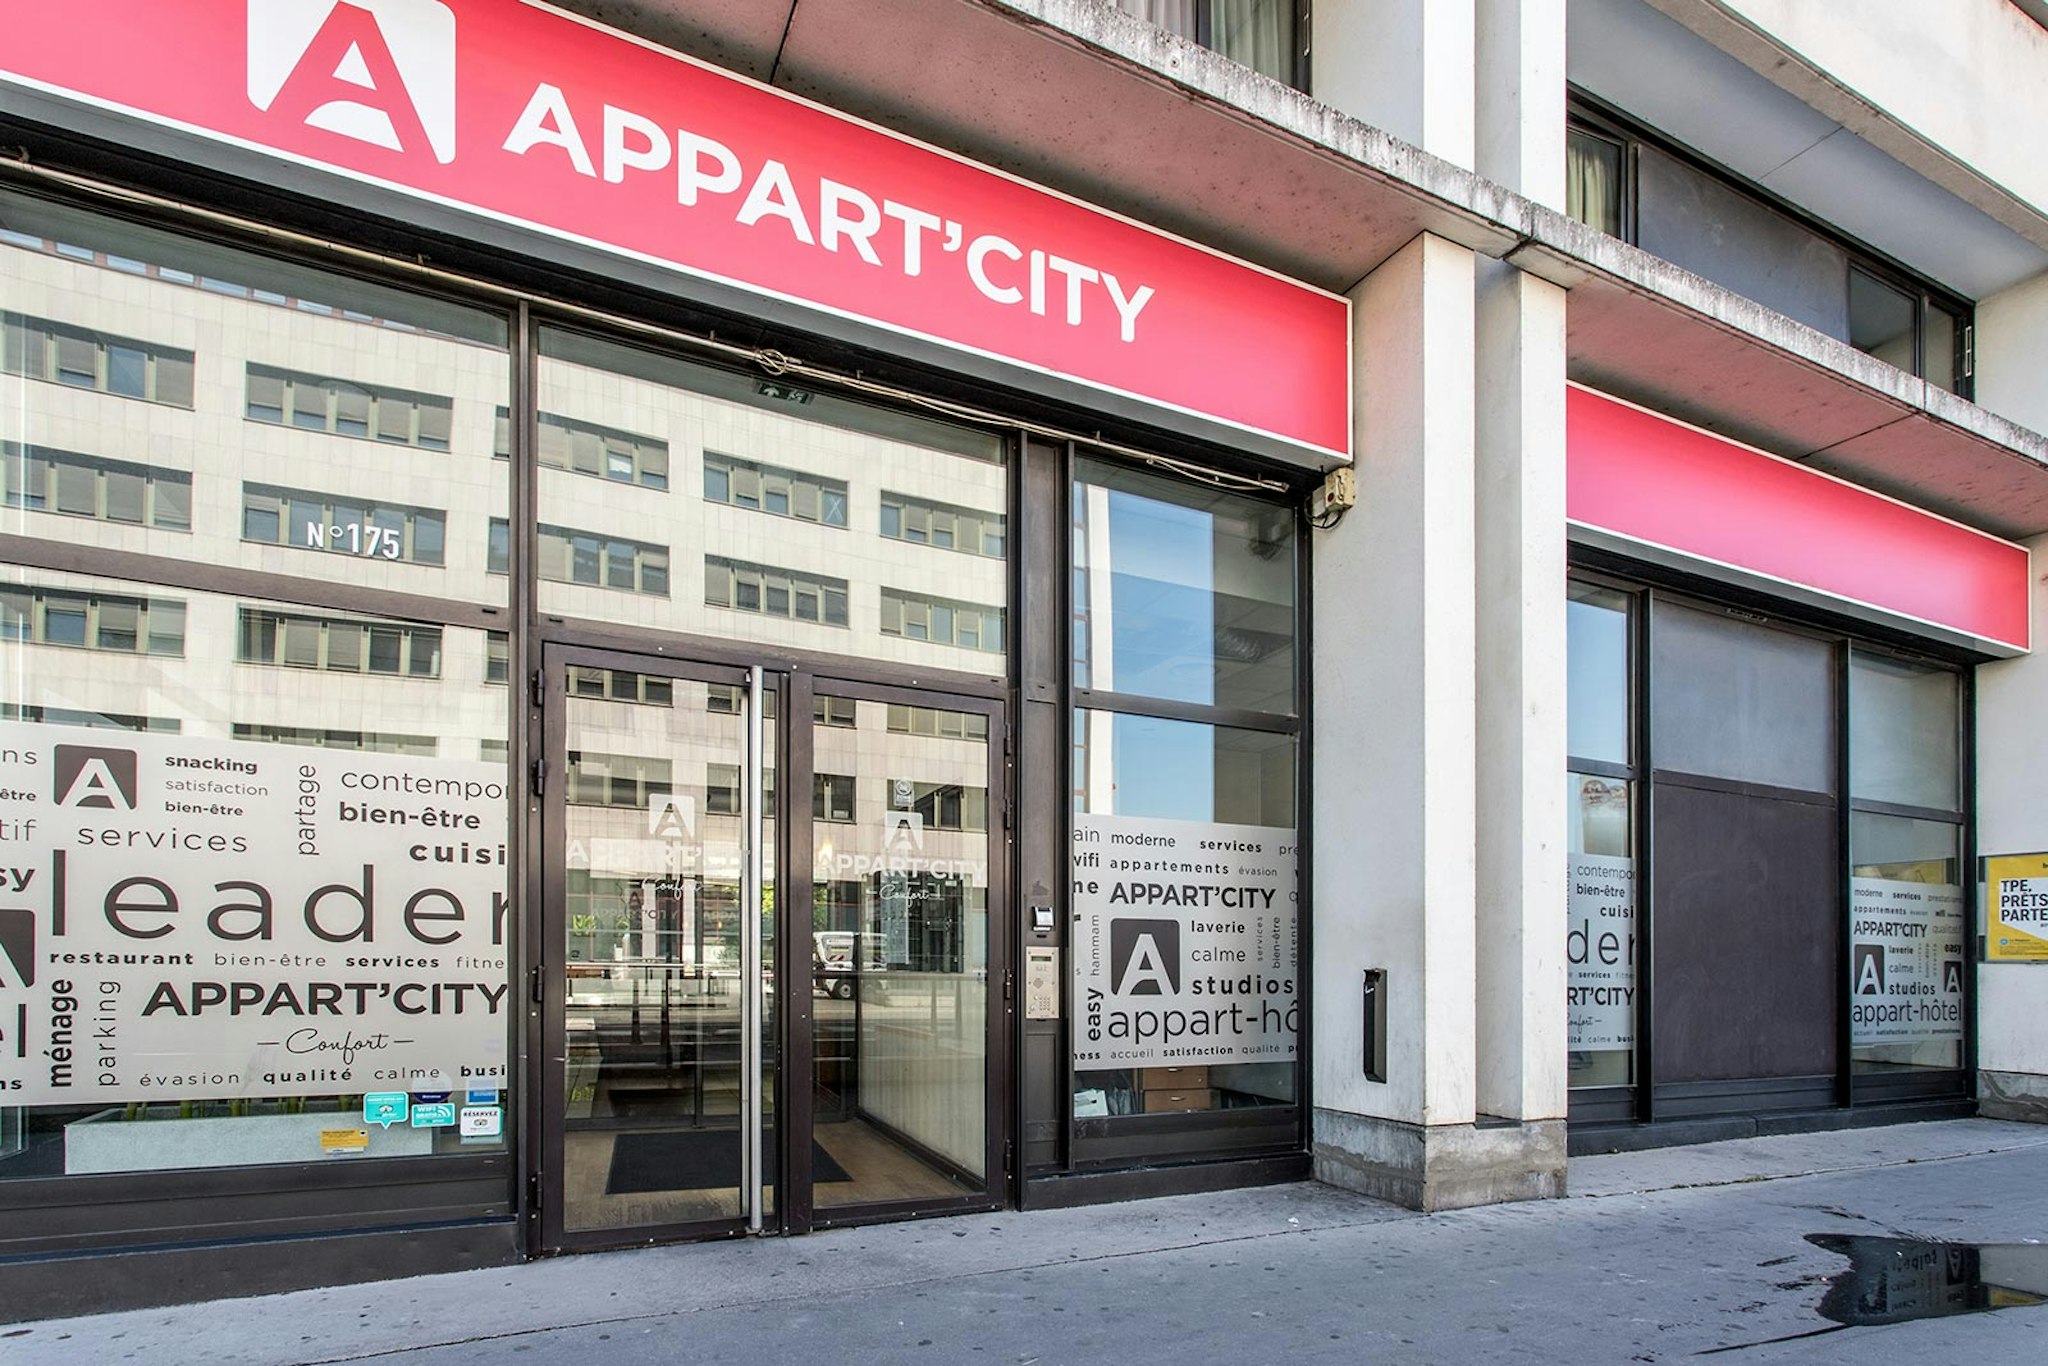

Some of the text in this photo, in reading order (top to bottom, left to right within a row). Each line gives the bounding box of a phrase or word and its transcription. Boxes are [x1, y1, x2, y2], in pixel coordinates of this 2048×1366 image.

[252, 0, 452, 163] A
[502, 82, 1155, 342] APPART'CITY
[165, 756, 257, 775] snacking
[165, 780, 269, 796] satisfaction
[165, 801, 244, 816] bien-être
[294, 765, 320, 855] partage
[339, 801, 480, 829] bien-être
[78, 826, 248, 853] services
[1111, 833, 1176, 847] moderne
[1200, 840, 1262, 853] services
[409, 842, 506, 866] cuisi
[1110, 859, 1229, 875] appartements
[1239, 865, 1278, 877] évasion
[53, 849, 508, 945] leader
[1110, 882, 1276, 909] APPART'CITY
[1576, 883, 1626, 898] bien-être
[1892, 891, 1921, 901] services
[1600, 905, 1634, 919] cuisi
[1191, 920, 1246, 934] laverie
[1256, 916, 1264, 962] services
[1854, 920, 1928, 937] APPART'CITY
[1090, 915, 1100, 976] hammam
[1191, 946, 1247, 962] calme
[1272, 916, 1281, 969] bien-être
[50, 952, 505, 969] restaurant bien-être services fitne
[1192, 975, 1294, 995] studios
[1889, 981, 1936, 996] studios
[141, 982, 508, 1017] APPART'CITY
[1088, 987, 1104, 1041] easy
[1853, 998, 1962, 1027] appart-hôtel
[44, 979, 78, 1088] ménage
[93, 981, 121, 1087] parking
[285, 1028, 389, 1065] Confort
[1110, 1049, 1154, 1060] accueil
[1163, 1046, 1233, 1058] satisfaction
[1242, 1043, 1280, 1054] qualité
[140, 1065, 506, 1087] évasion qualité calme busi
